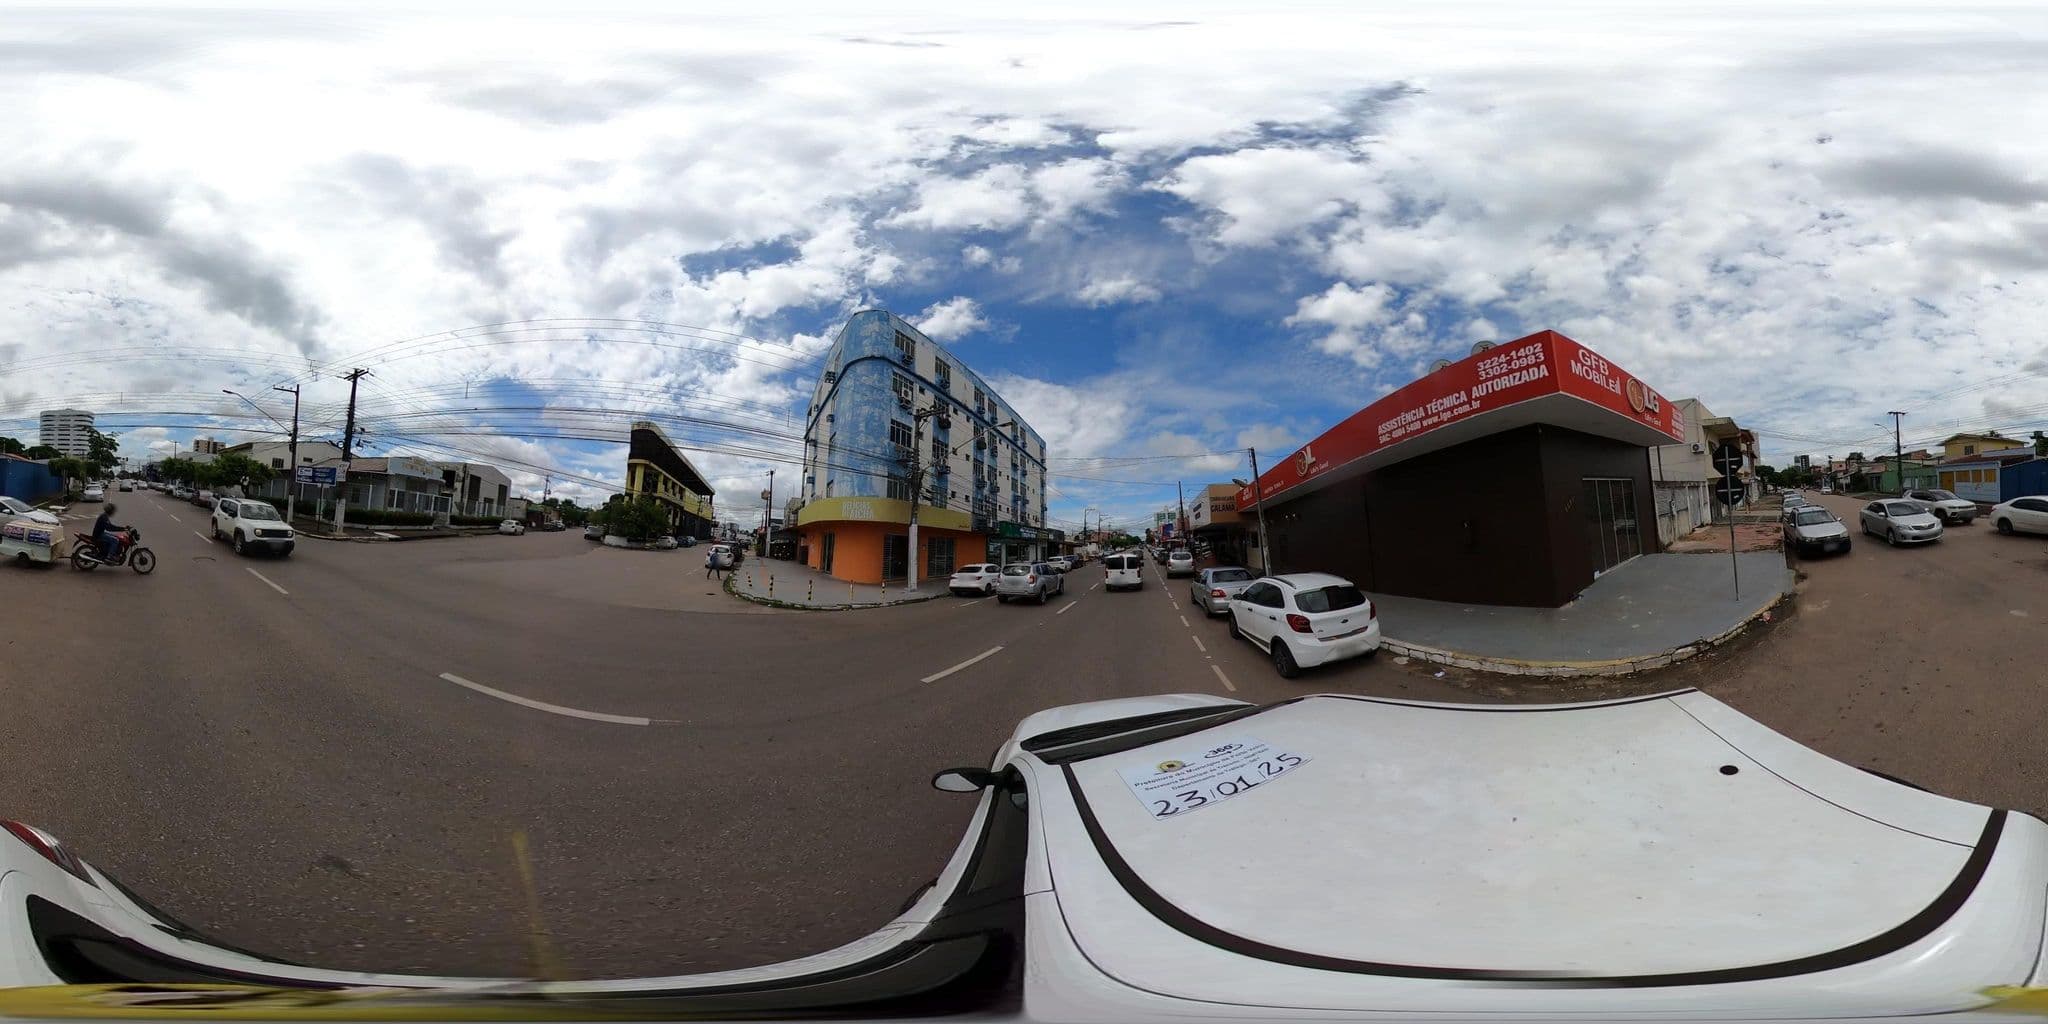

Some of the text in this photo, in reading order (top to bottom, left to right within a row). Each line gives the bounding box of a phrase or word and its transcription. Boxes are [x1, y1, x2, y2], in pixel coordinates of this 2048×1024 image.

[1477, 343, 1543, 371] 3224-1402
[1479, 352, 1545, 380] 3302-0983
[1578, 349, 1609, 376] GFB
[1377, 364, 1549, 435] ASSISTÊNCIA TÉCNICA AUTORIZADA
[1642, 385, 1660, 413] LG
[1210, 504, 1235, 512] CALAMA
